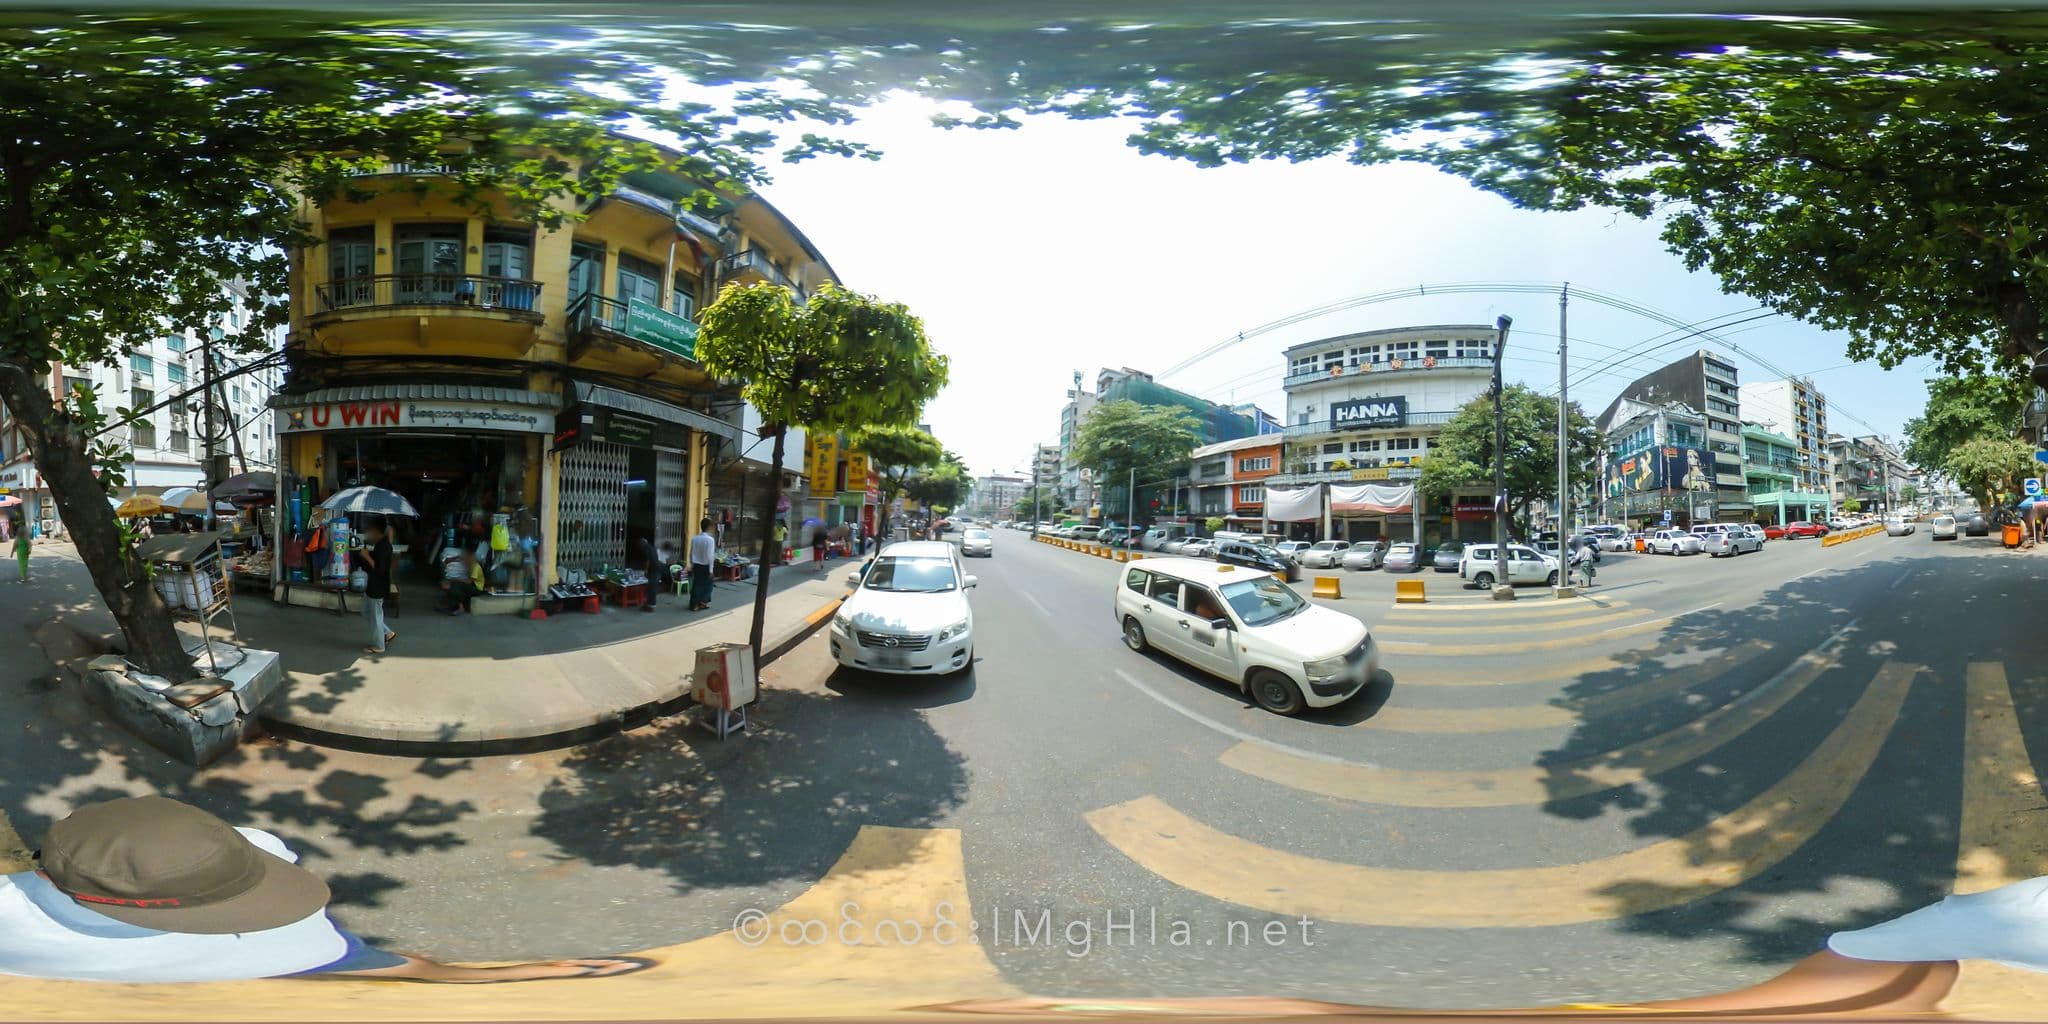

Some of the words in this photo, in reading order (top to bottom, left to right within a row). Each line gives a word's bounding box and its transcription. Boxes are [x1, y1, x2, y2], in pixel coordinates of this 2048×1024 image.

[312, 404, 330, 427] U
[339, 401, 400, 425] WIN
[1336, 402, 1399, 421] HANNA
